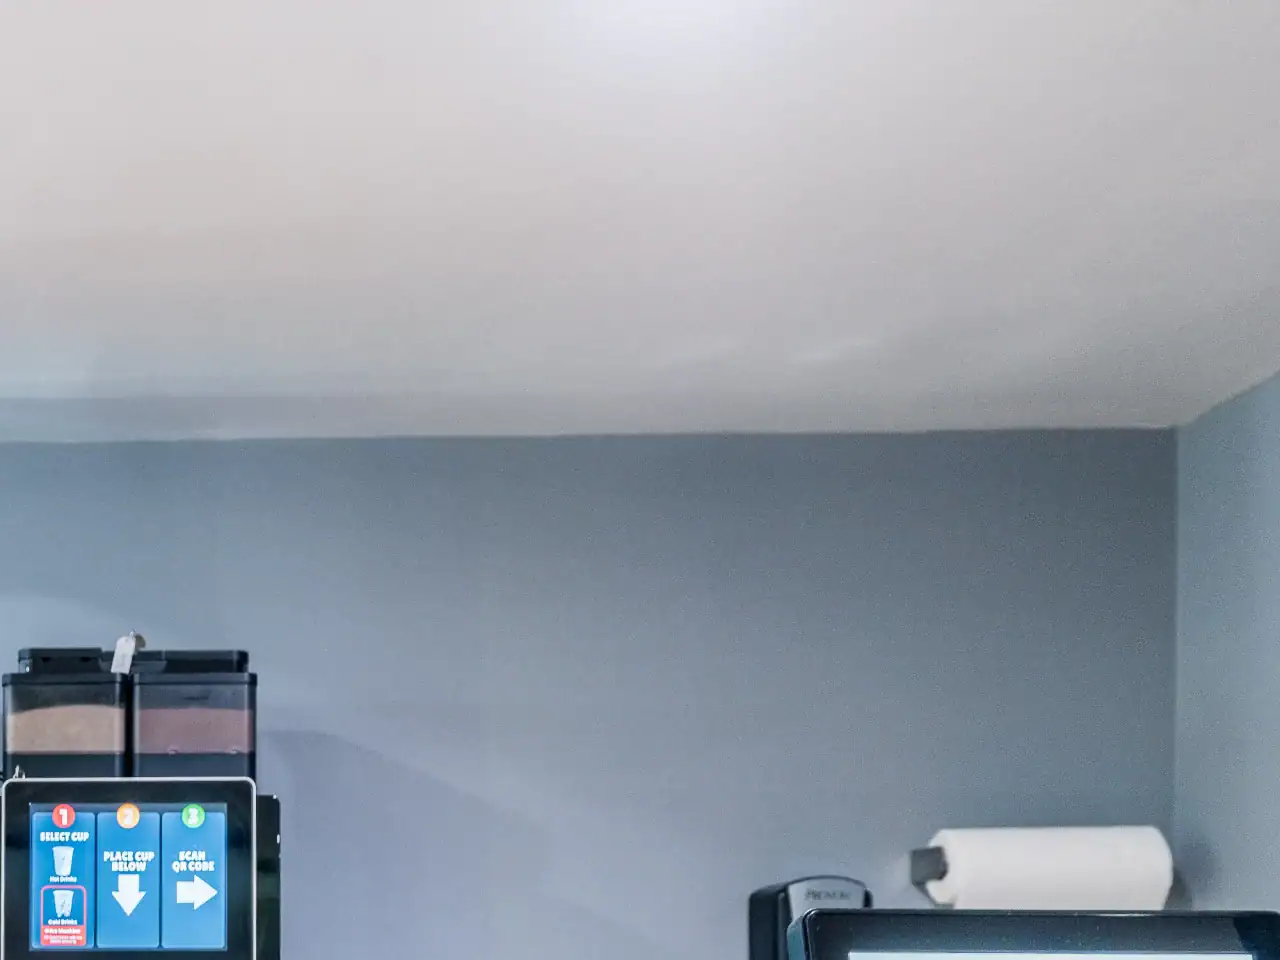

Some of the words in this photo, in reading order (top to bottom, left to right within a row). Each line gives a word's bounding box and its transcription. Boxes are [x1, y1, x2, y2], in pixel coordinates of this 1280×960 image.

[58, 808, 68, 826] 1
[123, 808, 135, 825] 2
[187, 808, 200, 825] 3
[40, 831, 71, 842] SELECT
[70, 831, 90, 842] CUP
[103, 851, 134, 861] PLACE
[134, 851, 155, 861] CUP
[178, 851, 206, 861] SCAN
[111, 861, 146, 872] BELOW
[171, 861, 189, 873] QR
[188, 861, 215, 872] CODE
